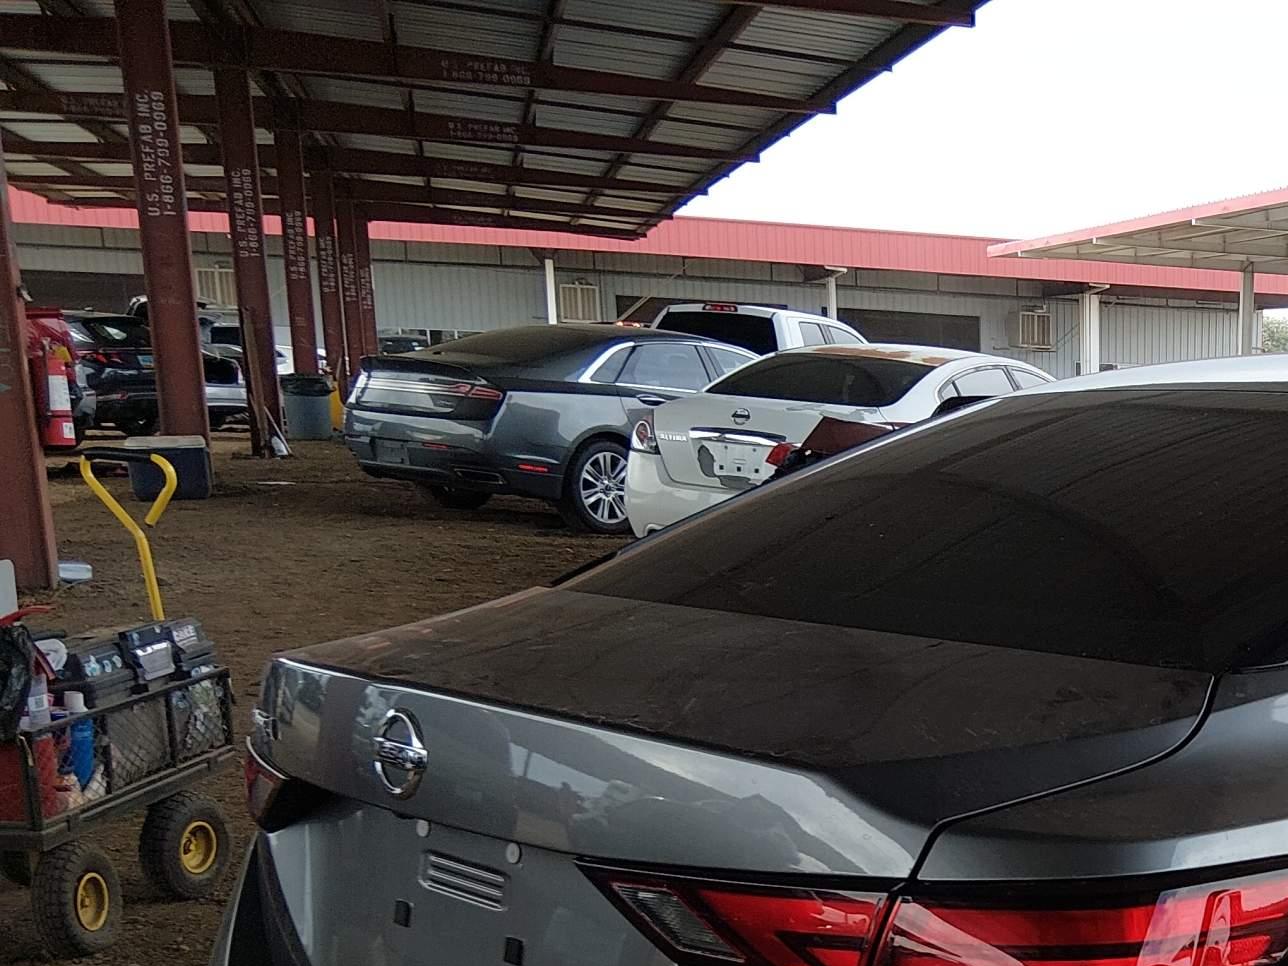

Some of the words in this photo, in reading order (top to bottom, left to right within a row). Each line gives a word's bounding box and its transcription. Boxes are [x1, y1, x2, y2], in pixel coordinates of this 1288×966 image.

[136, 89, 152, 118] INC.
[139, 124, 158, 181] PREFAB
[151, 90, 176, 217] 1-866-799-0969
